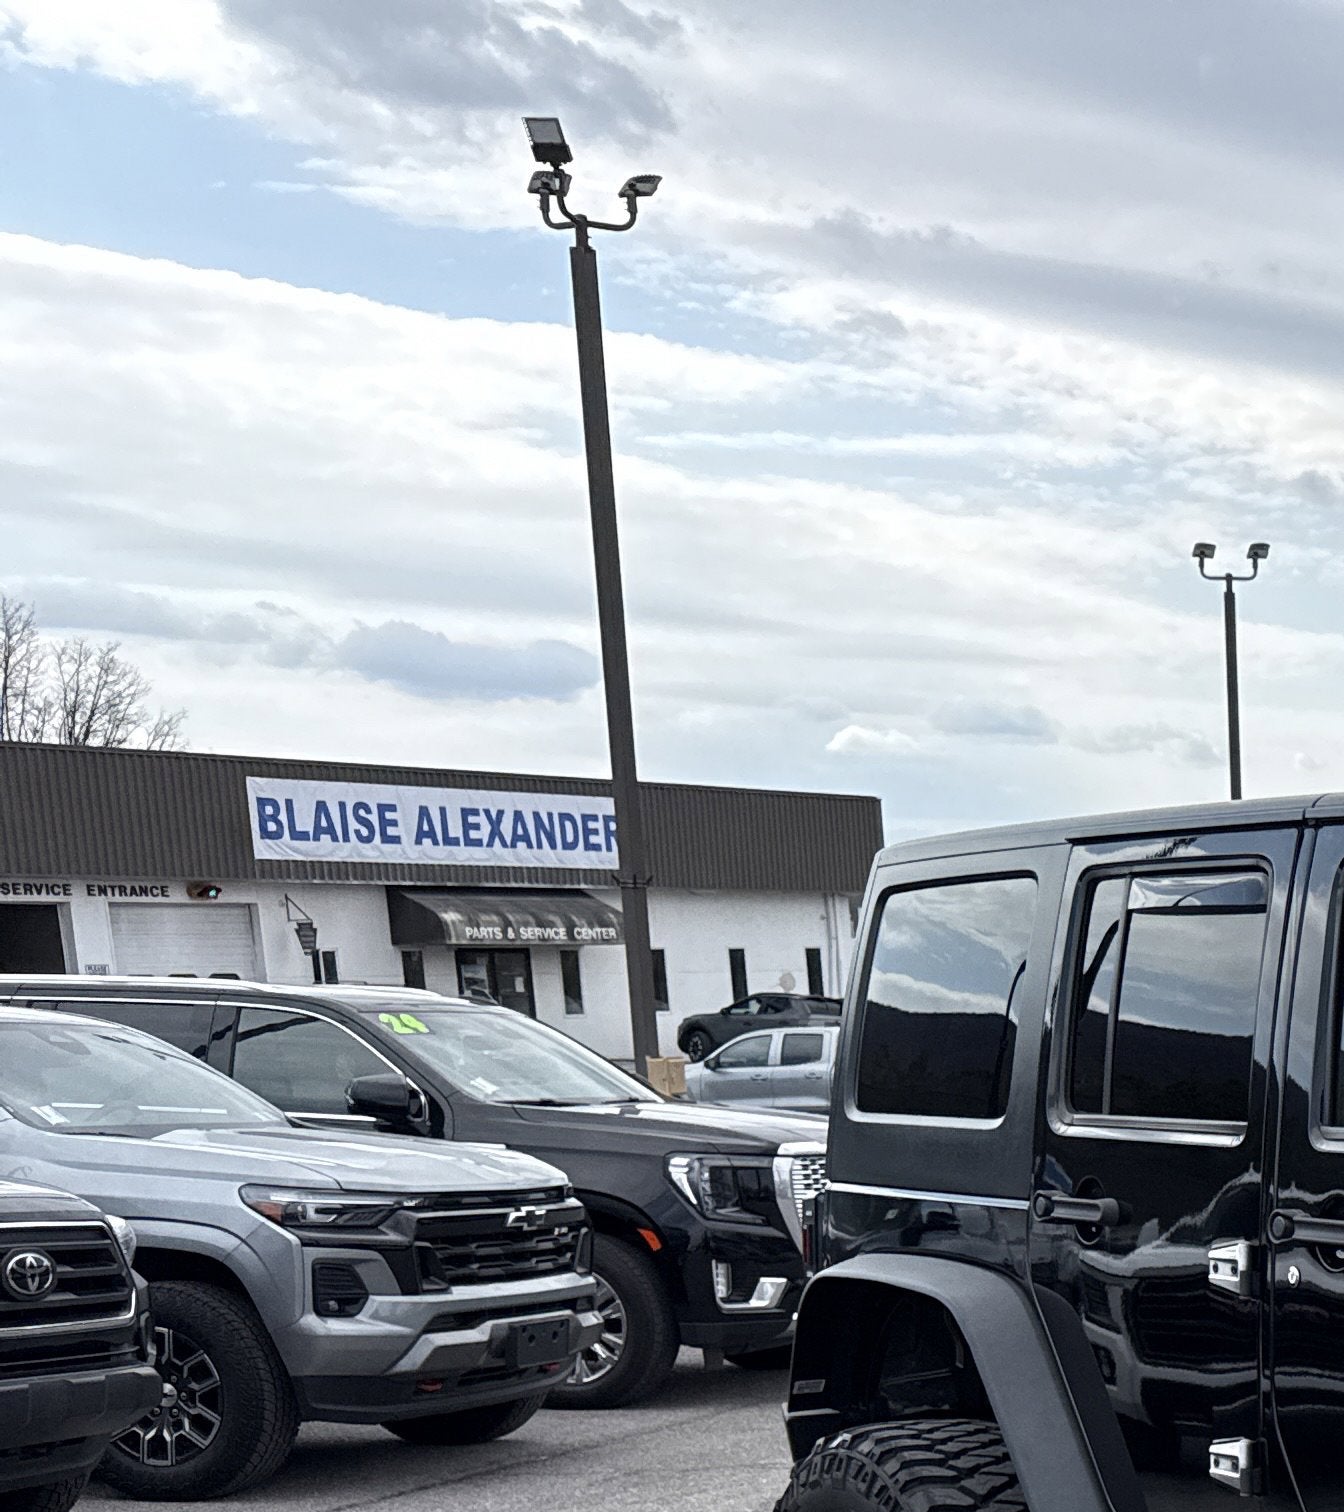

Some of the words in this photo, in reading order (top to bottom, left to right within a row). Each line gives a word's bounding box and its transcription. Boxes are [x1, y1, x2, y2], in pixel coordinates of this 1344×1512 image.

[256, 797, 402, 845] BLAISE
[0, 883, 73, 897] SERVICE
[86, 884, 170, 898] ENTRANCE
[465, 926, 503, 940] PARTS
[507, 926, 515, 940] &
[520, 926, 568, 940] SERVICE
[573, 927, 617, 940] CENTER
